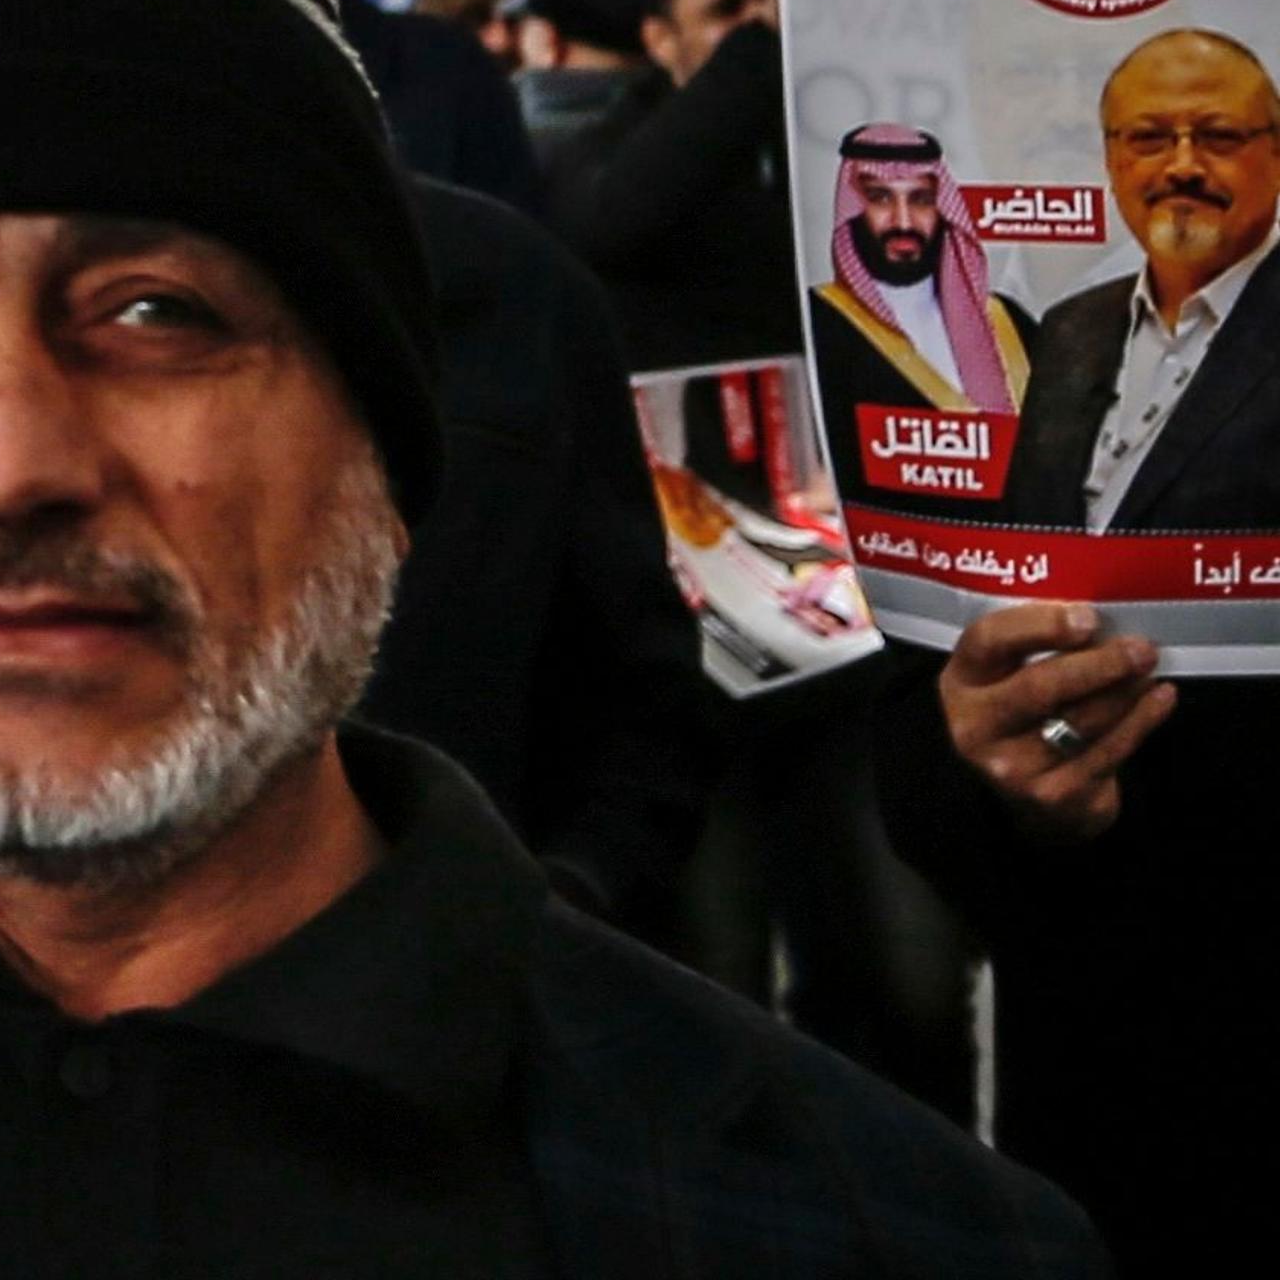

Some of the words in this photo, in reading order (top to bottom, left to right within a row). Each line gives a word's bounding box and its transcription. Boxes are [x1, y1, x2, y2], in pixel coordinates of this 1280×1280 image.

[978, 189, 1093, 228] الحاضر
[871, 415, 989, 460] القاتل
[900, 463, 983, 491] KATIL
[922, 543, 951, 571] من
[1020, 553, 1048, 584] لن
